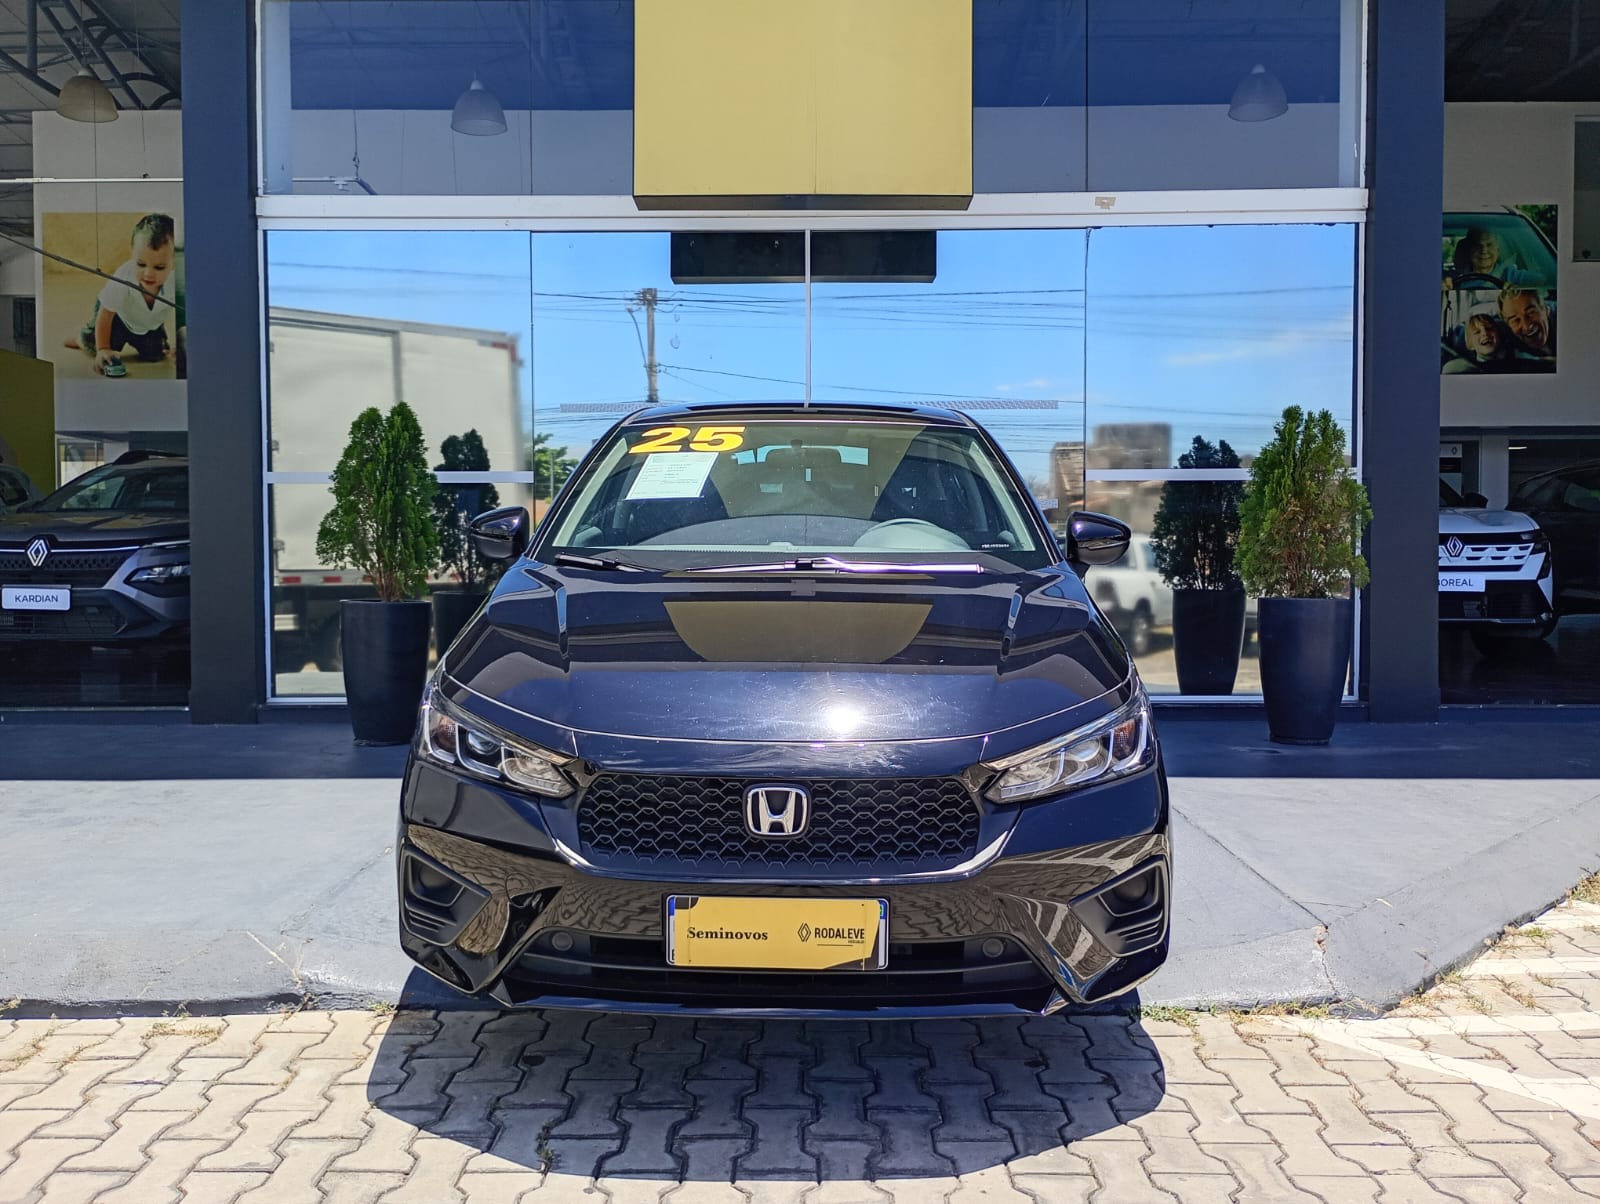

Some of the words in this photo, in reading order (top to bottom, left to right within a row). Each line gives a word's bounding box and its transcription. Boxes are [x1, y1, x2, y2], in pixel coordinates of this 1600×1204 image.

[628, 425, 746, 454] 25
[1438, 578, 1474, 587] OREAL
[14, 594, 59, 603] KARDIAN
[687, 926, 768, 941] Seminovos
[814, 927, 865, 940] RODALEVE
